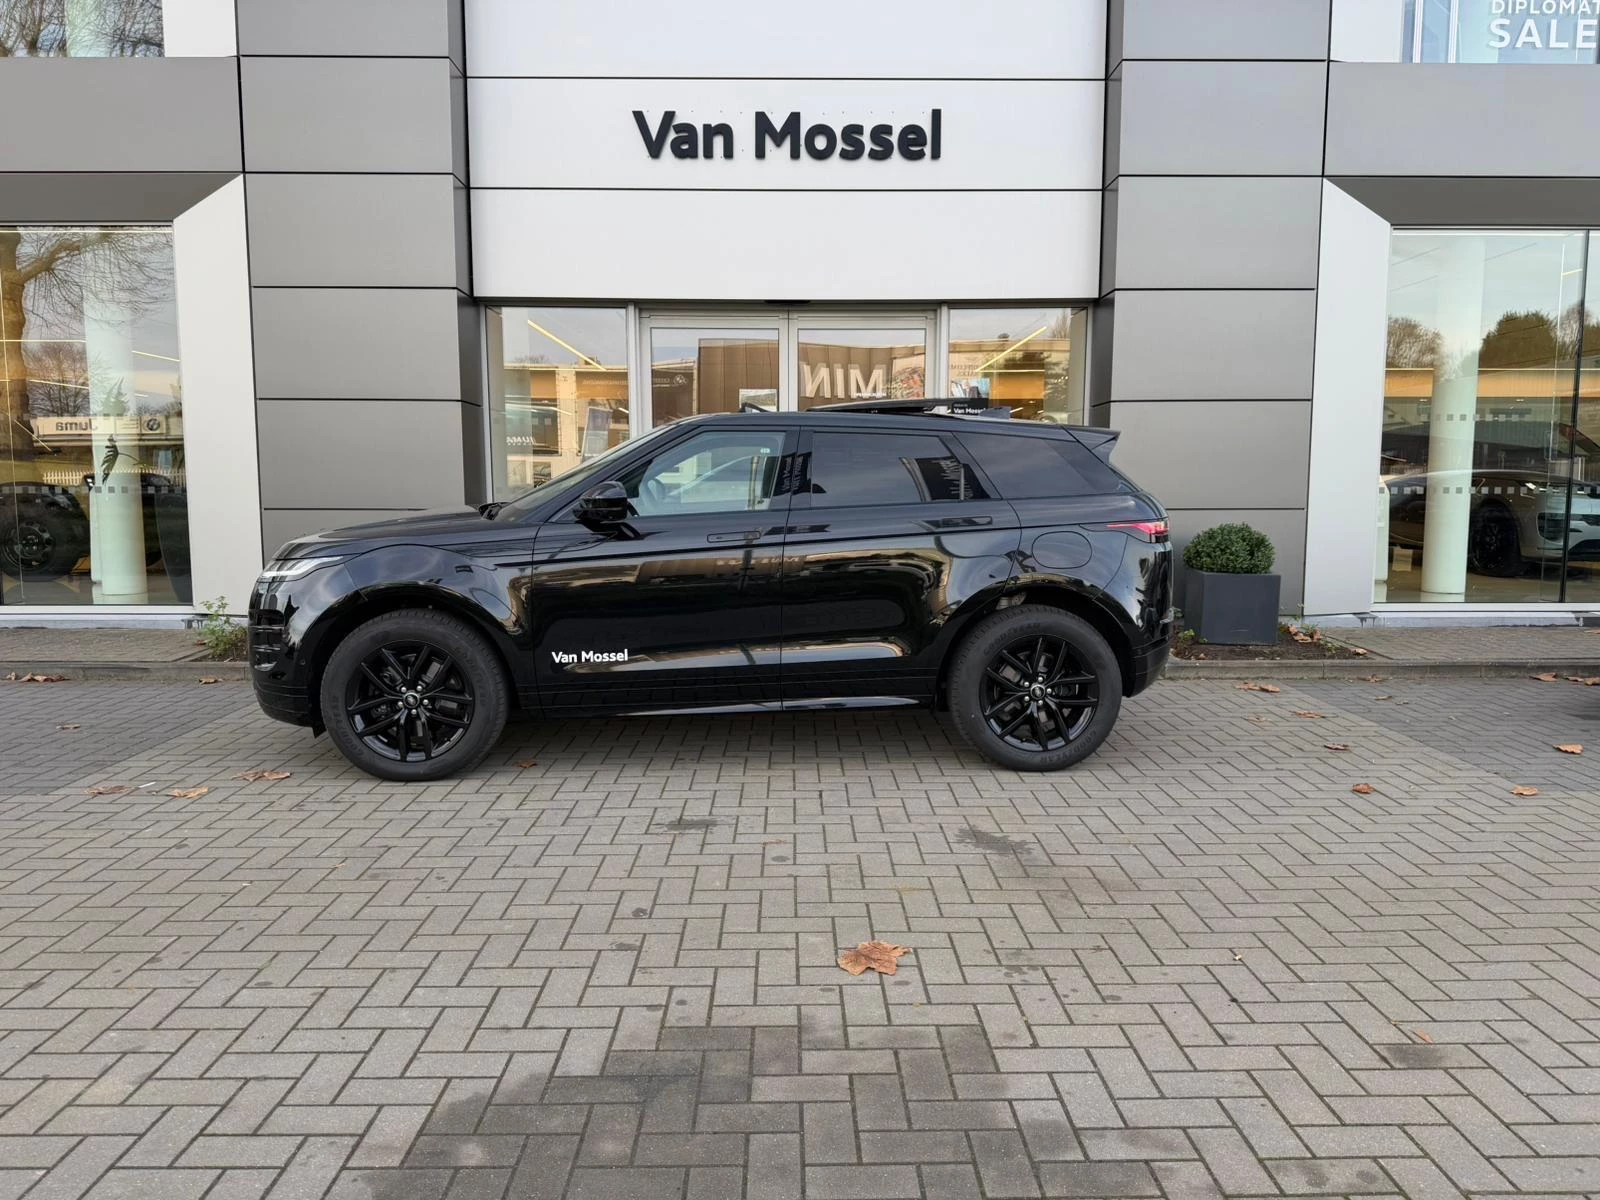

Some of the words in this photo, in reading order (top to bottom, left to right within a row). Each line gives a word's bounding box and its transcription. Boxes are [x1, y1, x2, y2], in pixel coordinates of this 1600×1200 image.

[1488, 18, 1598, 48] SALE
[632, 110, 734, 159] Van
[755, 108, 942, 161] Mossel
[551, 651, 578, 663] Van
[581, 648, 628, 662] Mossel
